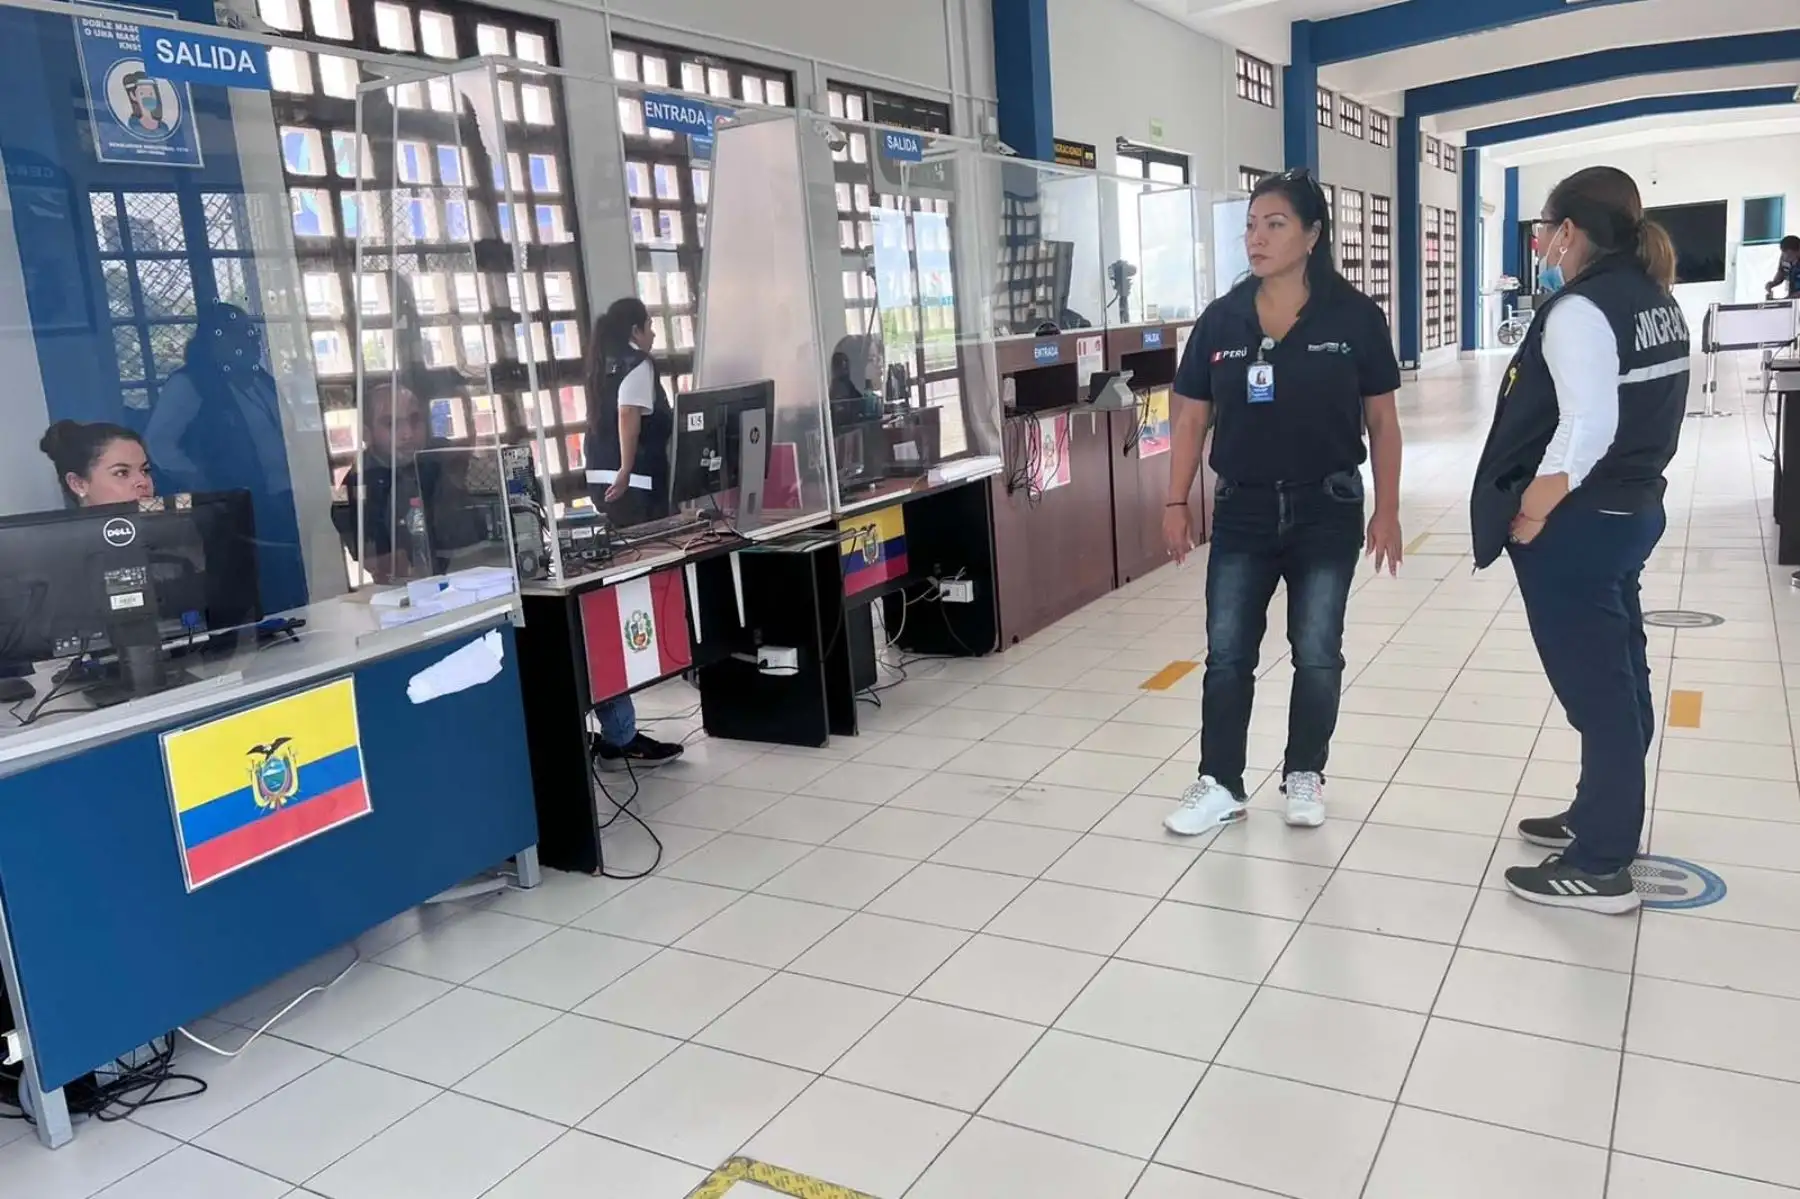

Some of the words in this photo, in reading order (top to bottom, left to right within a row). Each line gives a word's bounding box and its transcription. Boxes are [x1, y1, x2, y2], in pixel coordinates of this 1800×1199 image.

[155, 38, 257, 74] SALIDA
[644, 100, 707, 126] ENTRADA
[886, 135, 919, 152] SALIDA
[1222, 346, 1248, 359] PERÚ
[107, 528, 131, 537] DELL
